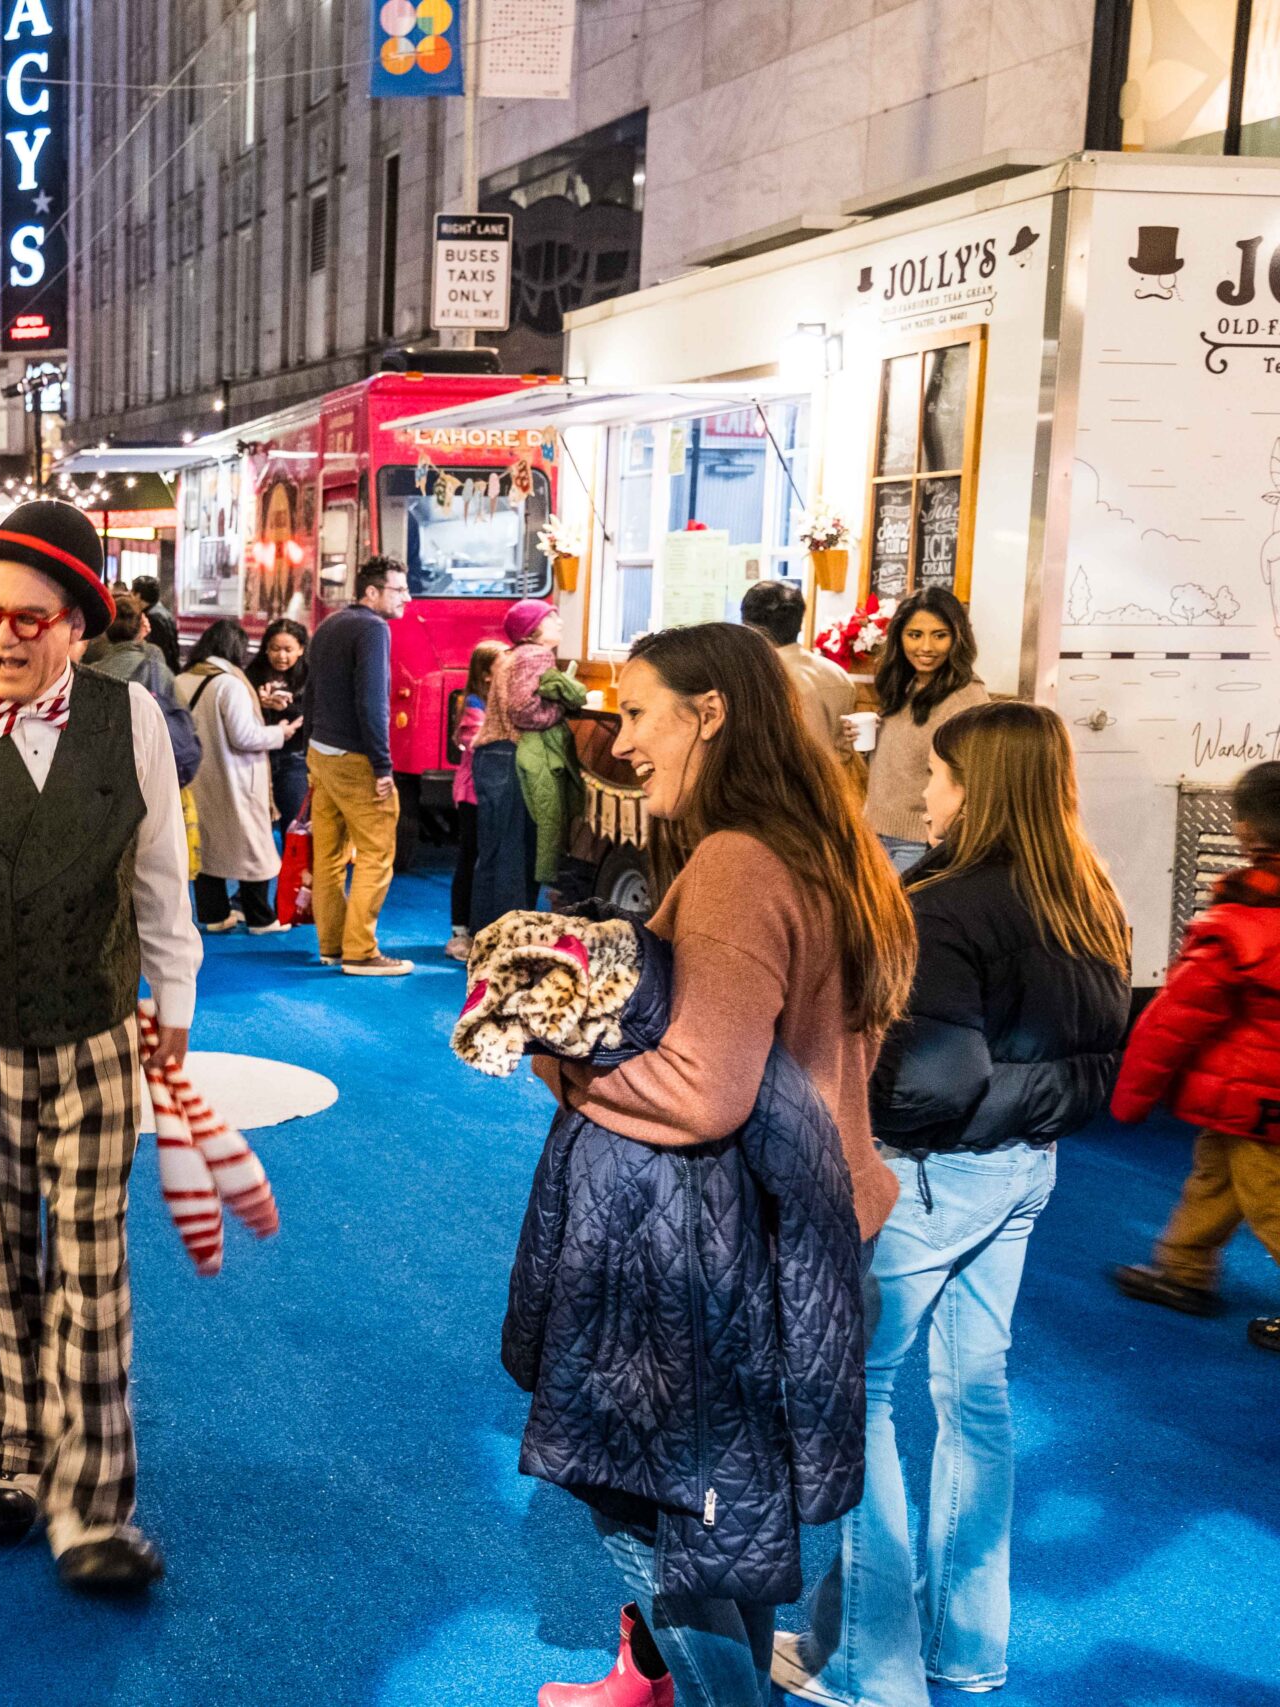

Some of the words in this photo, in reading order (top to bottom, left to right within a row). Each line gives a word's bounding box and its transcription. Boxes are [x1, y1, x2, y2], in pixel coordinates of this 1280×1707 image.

[440, 222, 472, 235] RIGHT
[476, 223, 506, 236] LANE
[445, 249, 500, 262] BUSES
[447, 269, 496, 282] TAXIS
[883, 238, 997, 301] JOLLY'S
[447, 289, 494, 303] ONLY
[440, 309, 450, 318] AT
[454, 309, 469, 319] ALL
[474, 309, 500, 319] TIMES
[414, 428, 520, 447] LAHORE
[923, 532, 952, 562] ICE
[921, 560, 952, 576] CREAM
[1192, 717, 1267, 767] Wander
